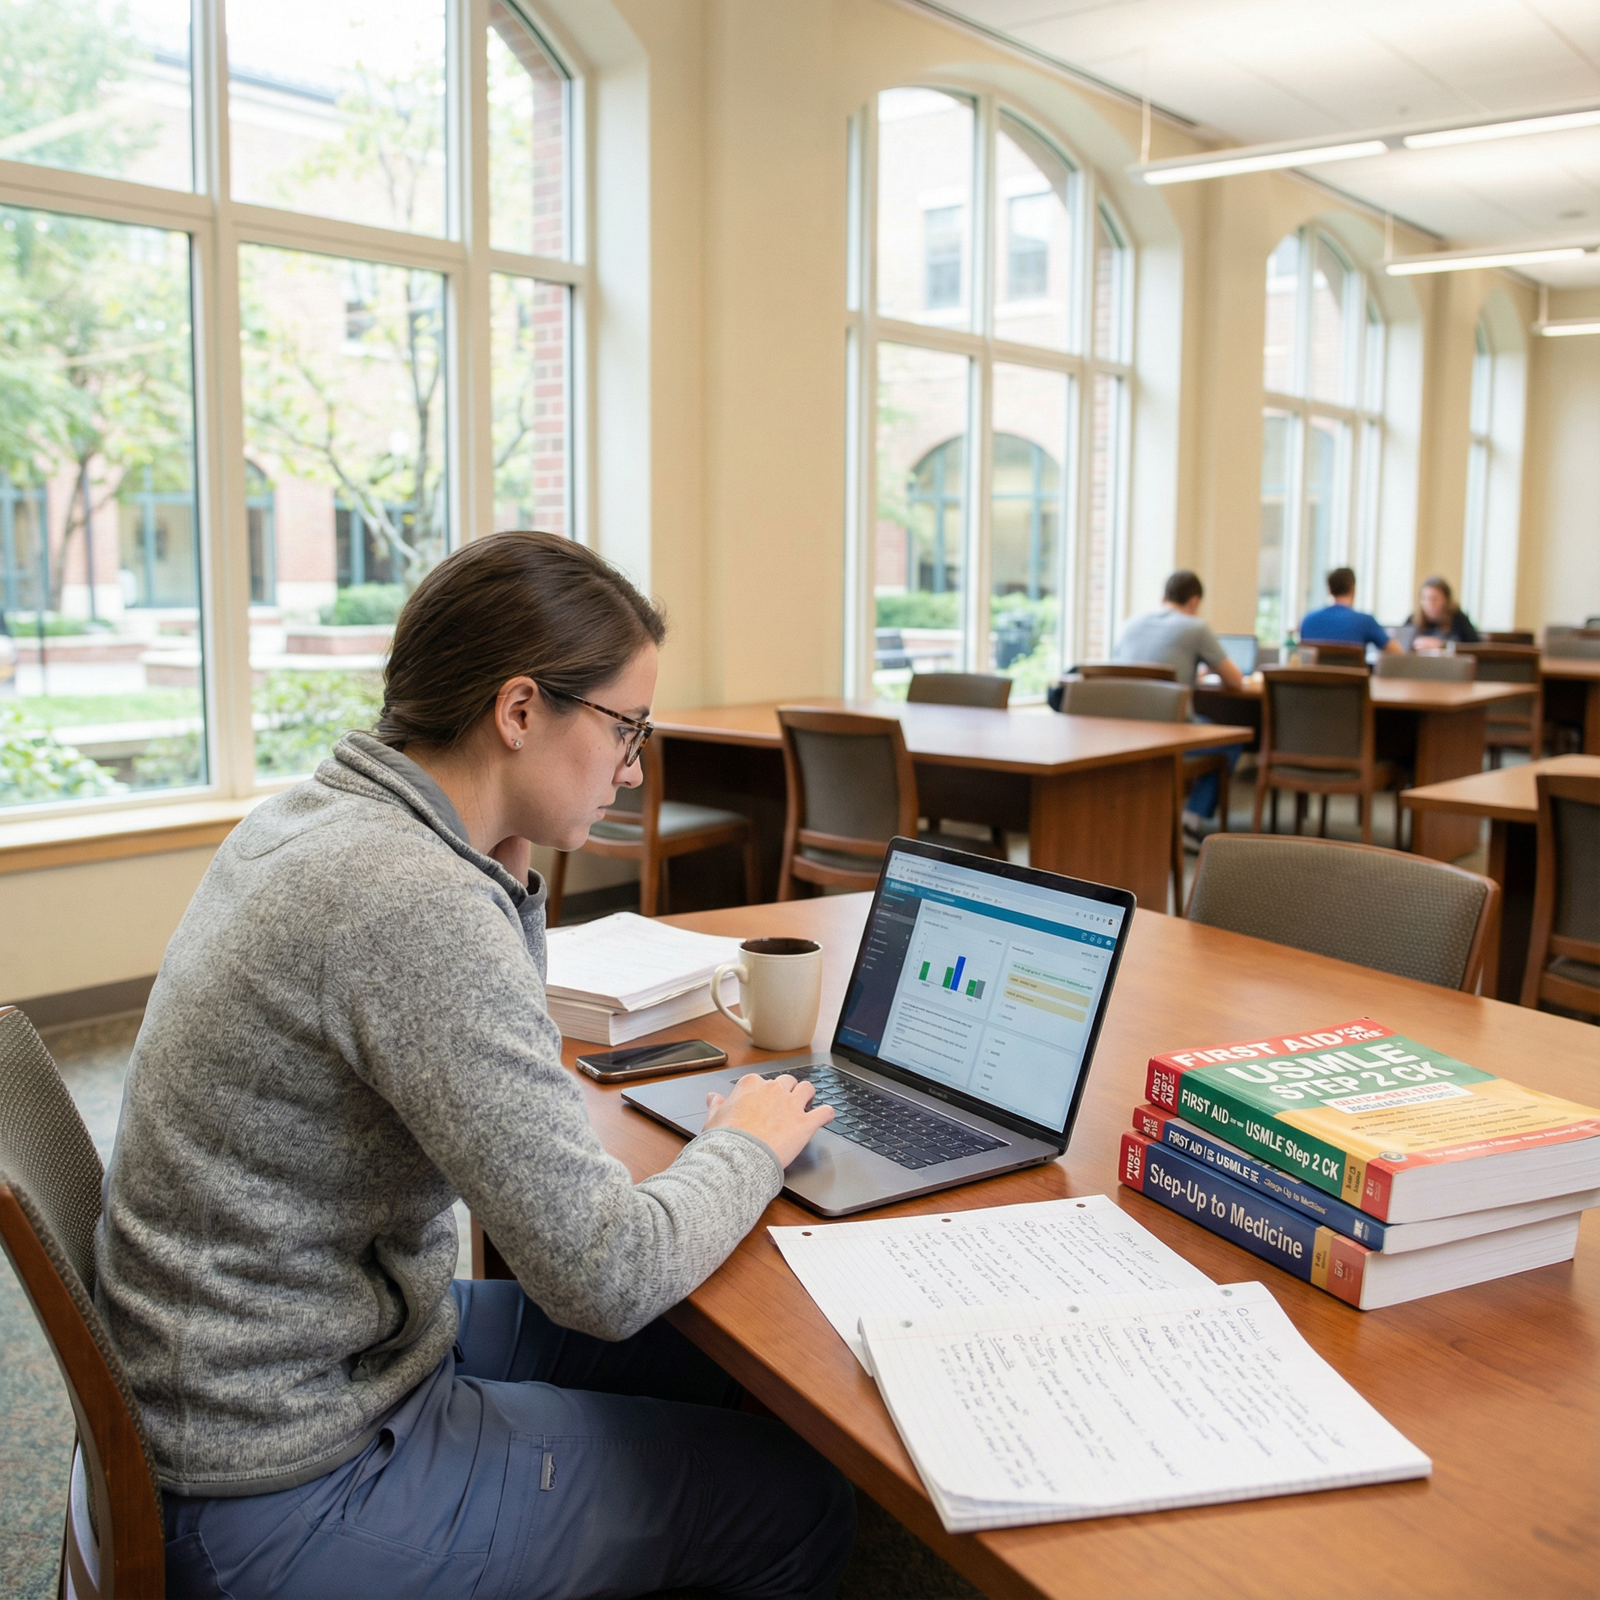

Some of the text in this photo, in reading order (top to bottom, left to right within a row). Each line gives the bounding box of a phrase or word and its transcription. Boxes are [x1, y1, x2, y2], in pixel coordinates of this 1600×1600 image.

[1171, 1032, 1343, 1067] FIRST AID
[1224, 1042, 1418, 1083] USMLE
[1269, 1073, 1360, 1100] STEP
[1359, 1070, 1397, 1087] 2
[1397, 1062, 1455, 1083] CK
[1181, 1089, 1210, 1114] FIRST
[1211, 1102, 1229, 1124] AID
[1245, 1120, 1283, 1152] USMLE
[1284, 1140, 1310, 1168] Step
[1311, 1153, 1320, 1171] 2
[1321, 1158, 1340, 1181] CK
[1149, 1163, 1207, 1212] Step-Up
[1210, 1194, 1226, 1219] to
[1230, 1203, 1303, 1259] Medicine
